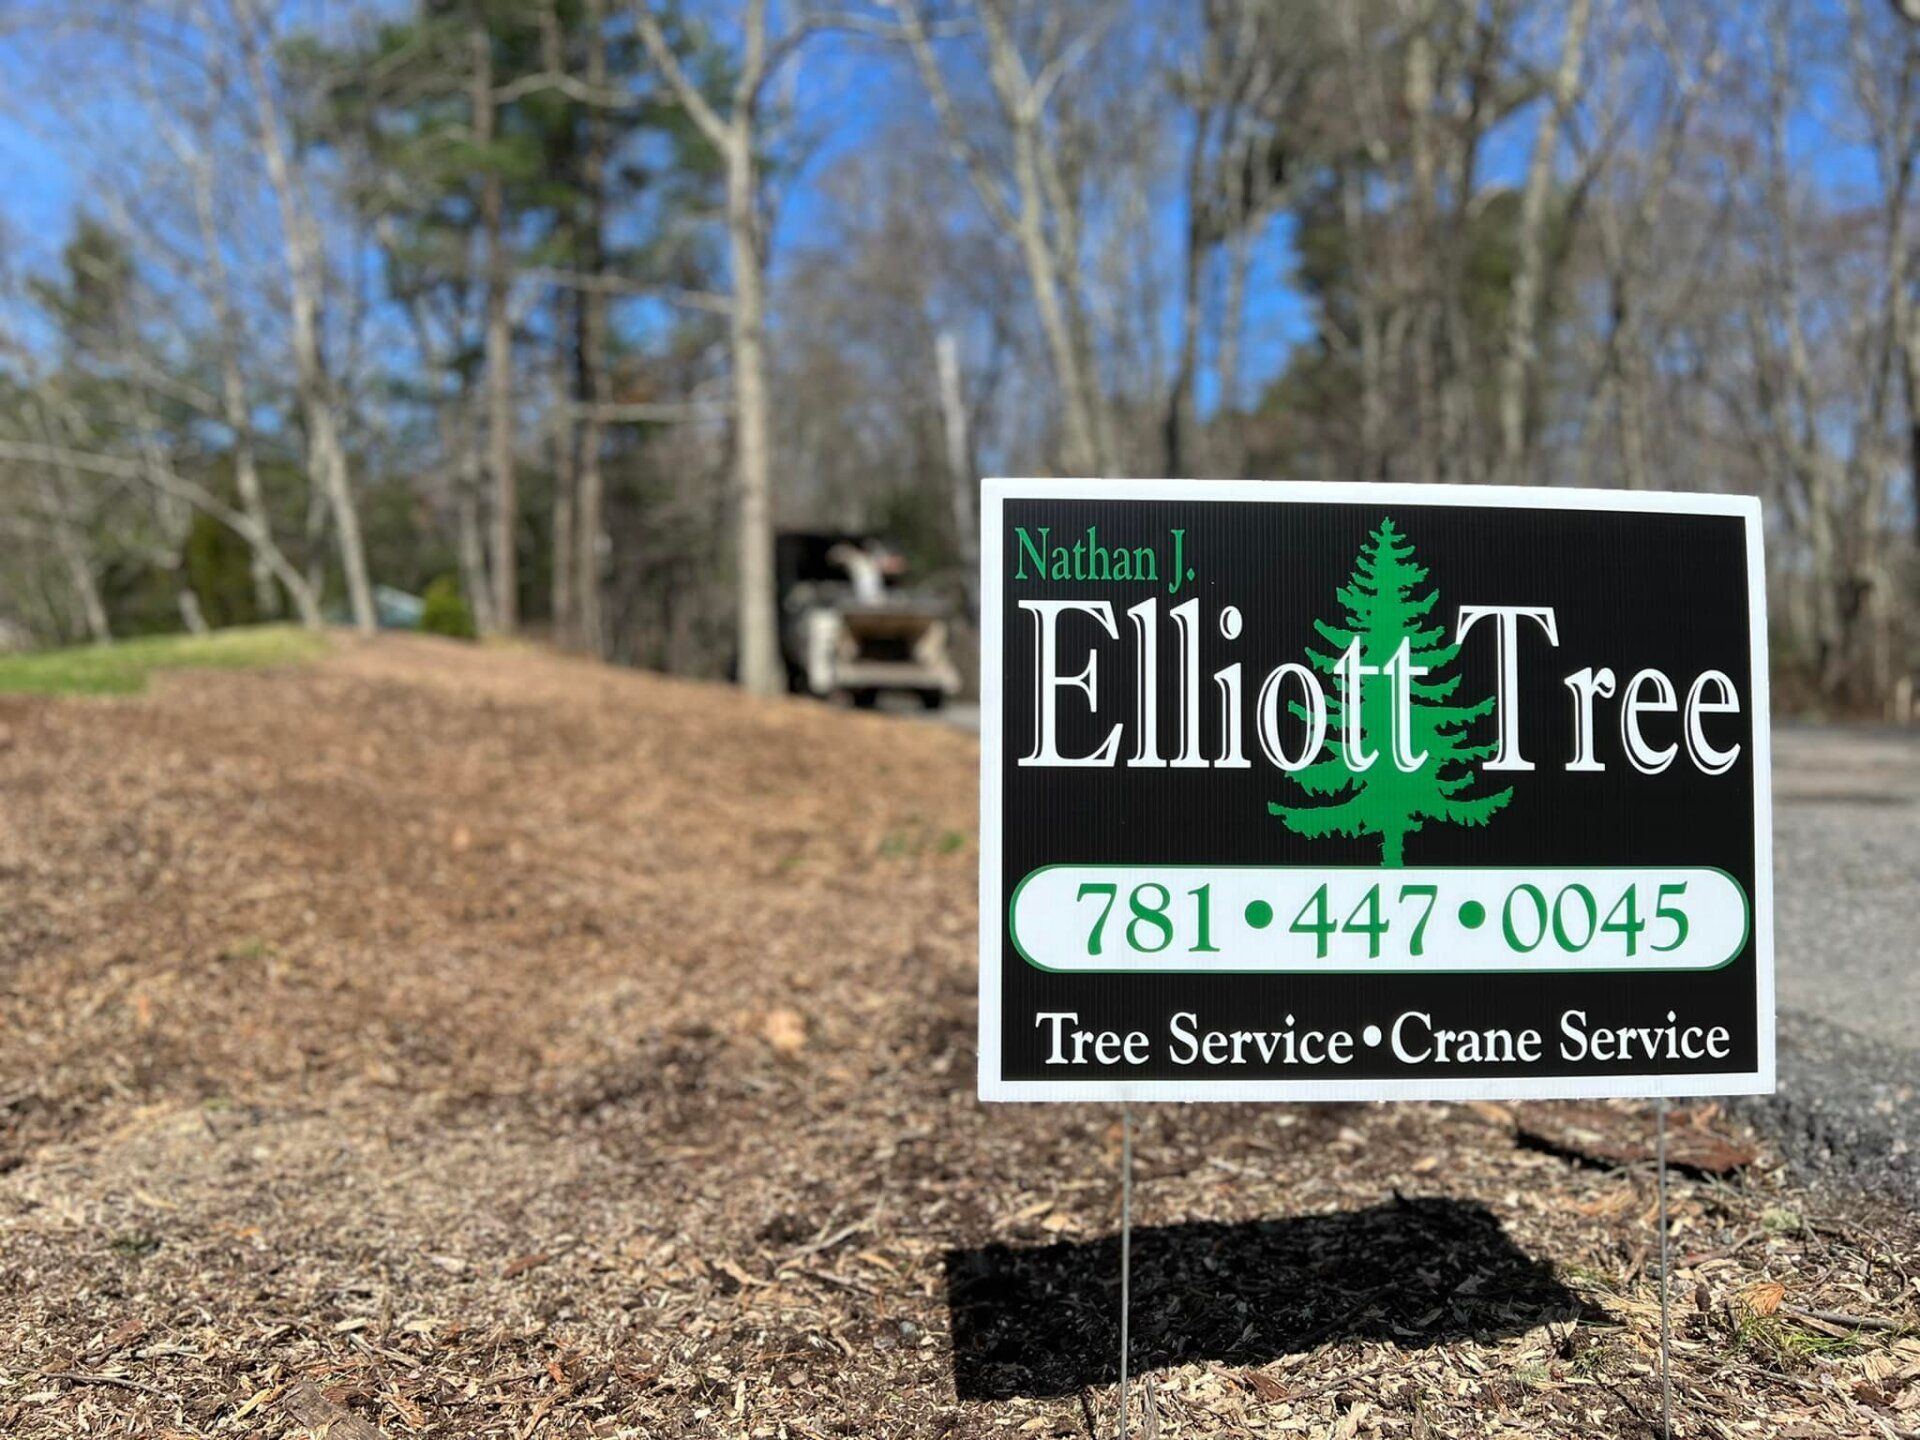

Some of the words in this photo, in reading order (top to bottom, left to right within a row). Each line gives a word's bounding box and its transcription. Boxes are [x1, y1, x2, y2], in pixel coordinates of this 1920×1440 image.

[1014, 526, 1158, 581] Nathan
[1168, 528, 1196, 594] J.
[1017, 597, 1429, 773] Elliott
[1454, 604, 1742, 776] Tree
[1035, 1012, 1150, 1066] Tree
[1169, 1013, 1354, 1065] Service
[1390, 1010, 1542, 1064] Crane
[1560, 1008, 1730, 1061] Service
